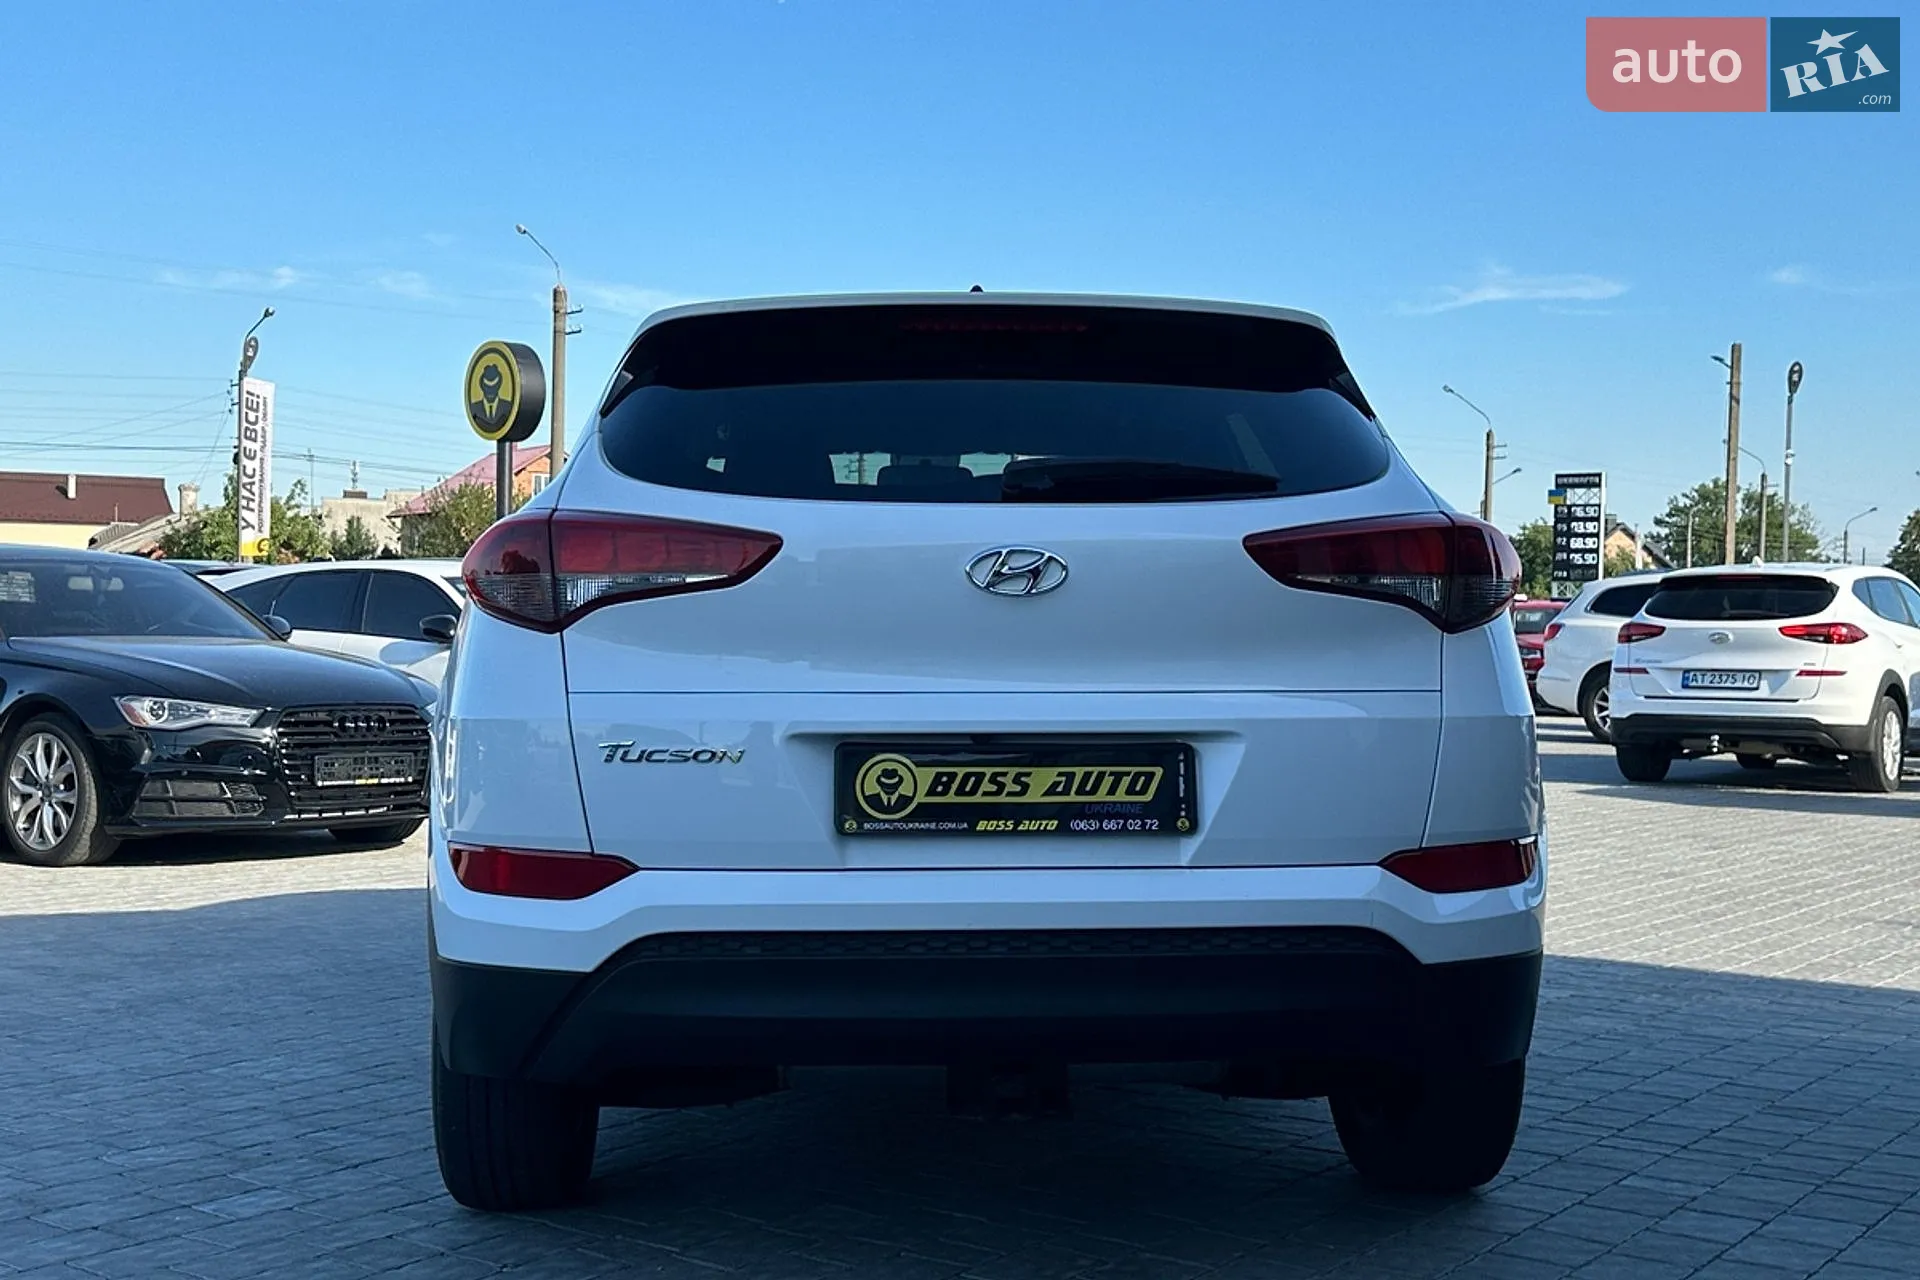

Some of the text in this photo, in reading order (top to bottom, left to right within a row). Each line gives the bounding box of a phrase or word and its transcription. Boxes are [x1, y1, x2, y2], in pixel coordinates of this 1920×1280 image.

[241, 390, 261, 531] У НАС Є ВСЕ!
[1690, 673, 1709, 684] AT
[1709, 673, 1738, 685] 2375
[924, 771, 1032, 797] BOSS
[1040, 771, 1157, 796] AUTO
[1085, 803, 1144, 814] UKRAINE
[976, 820, 1059, 831] BOSS AUTO
[1070, 819, 1159, 831] (063) 667 02 72
